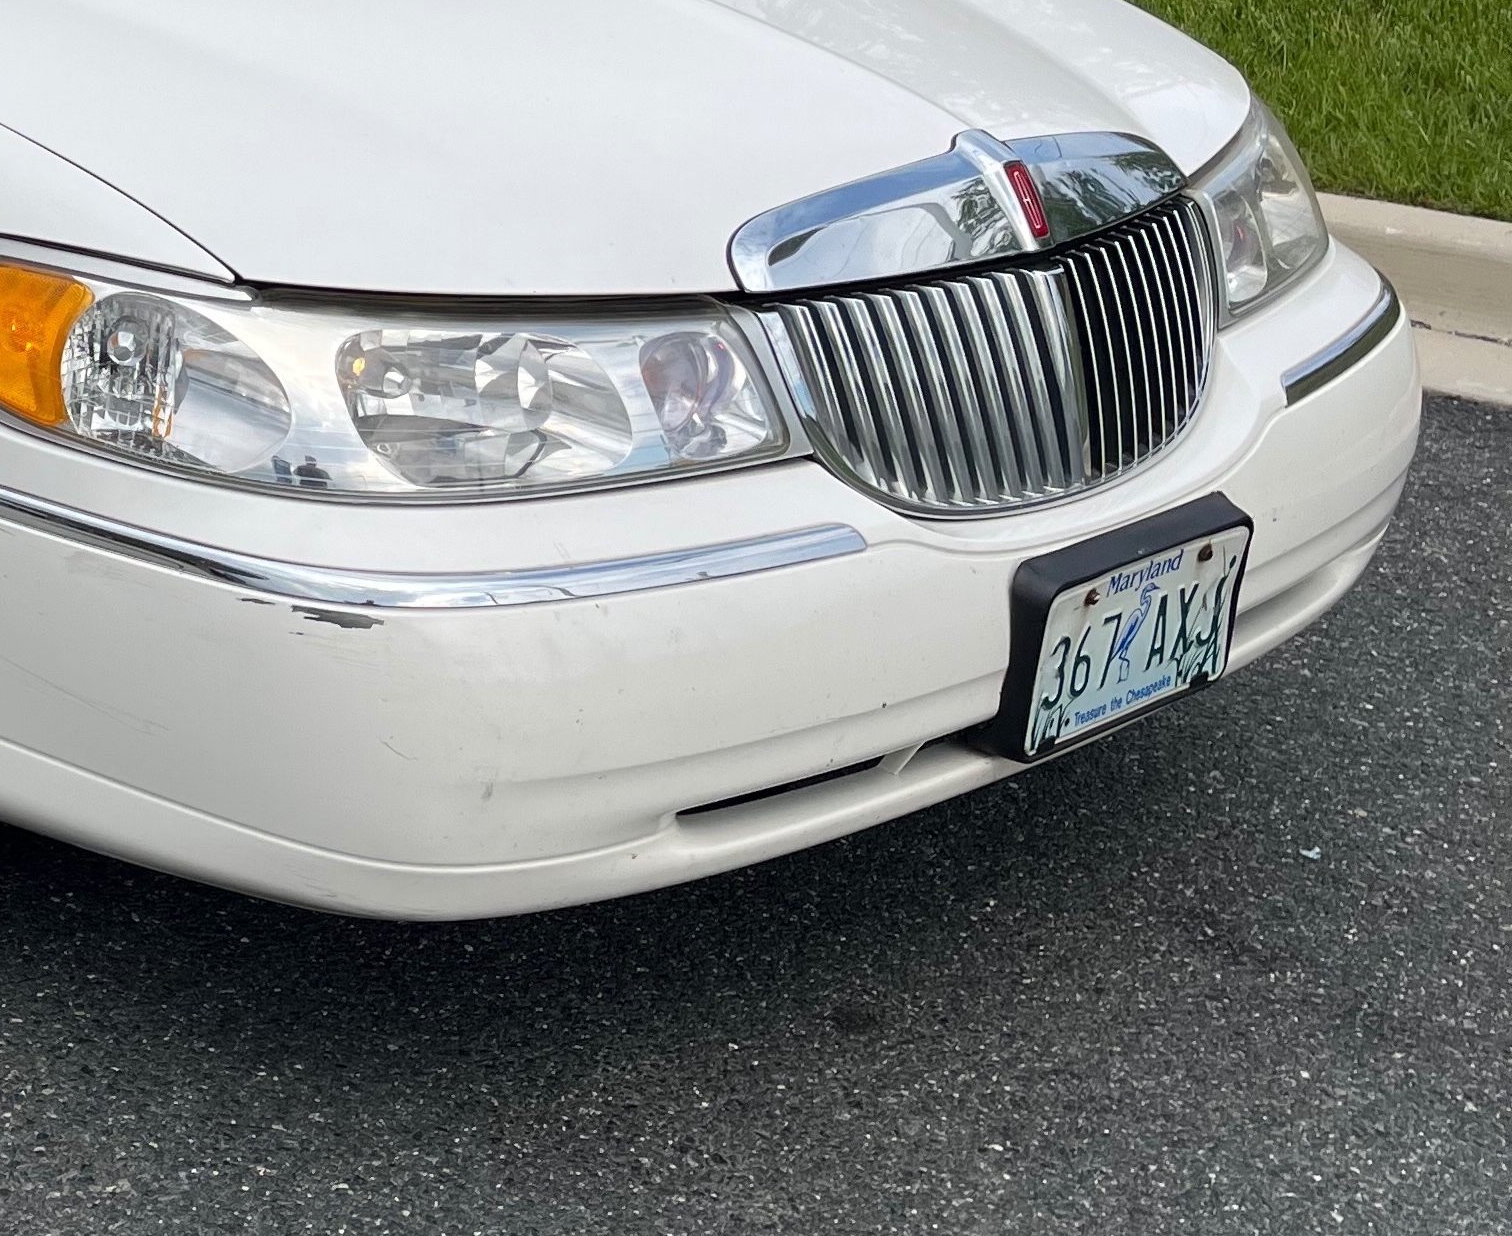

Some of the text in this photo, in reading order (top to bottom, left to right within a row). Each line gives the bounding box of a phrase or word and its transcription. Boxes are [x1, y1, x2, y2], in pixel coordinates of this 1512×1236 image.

[1105, 549, 1184, 598] Maryland
[1041, 576, 1227, 711] 367 AXJ
[1075, 675, 1171, 726] Treasure the Chesapeake
